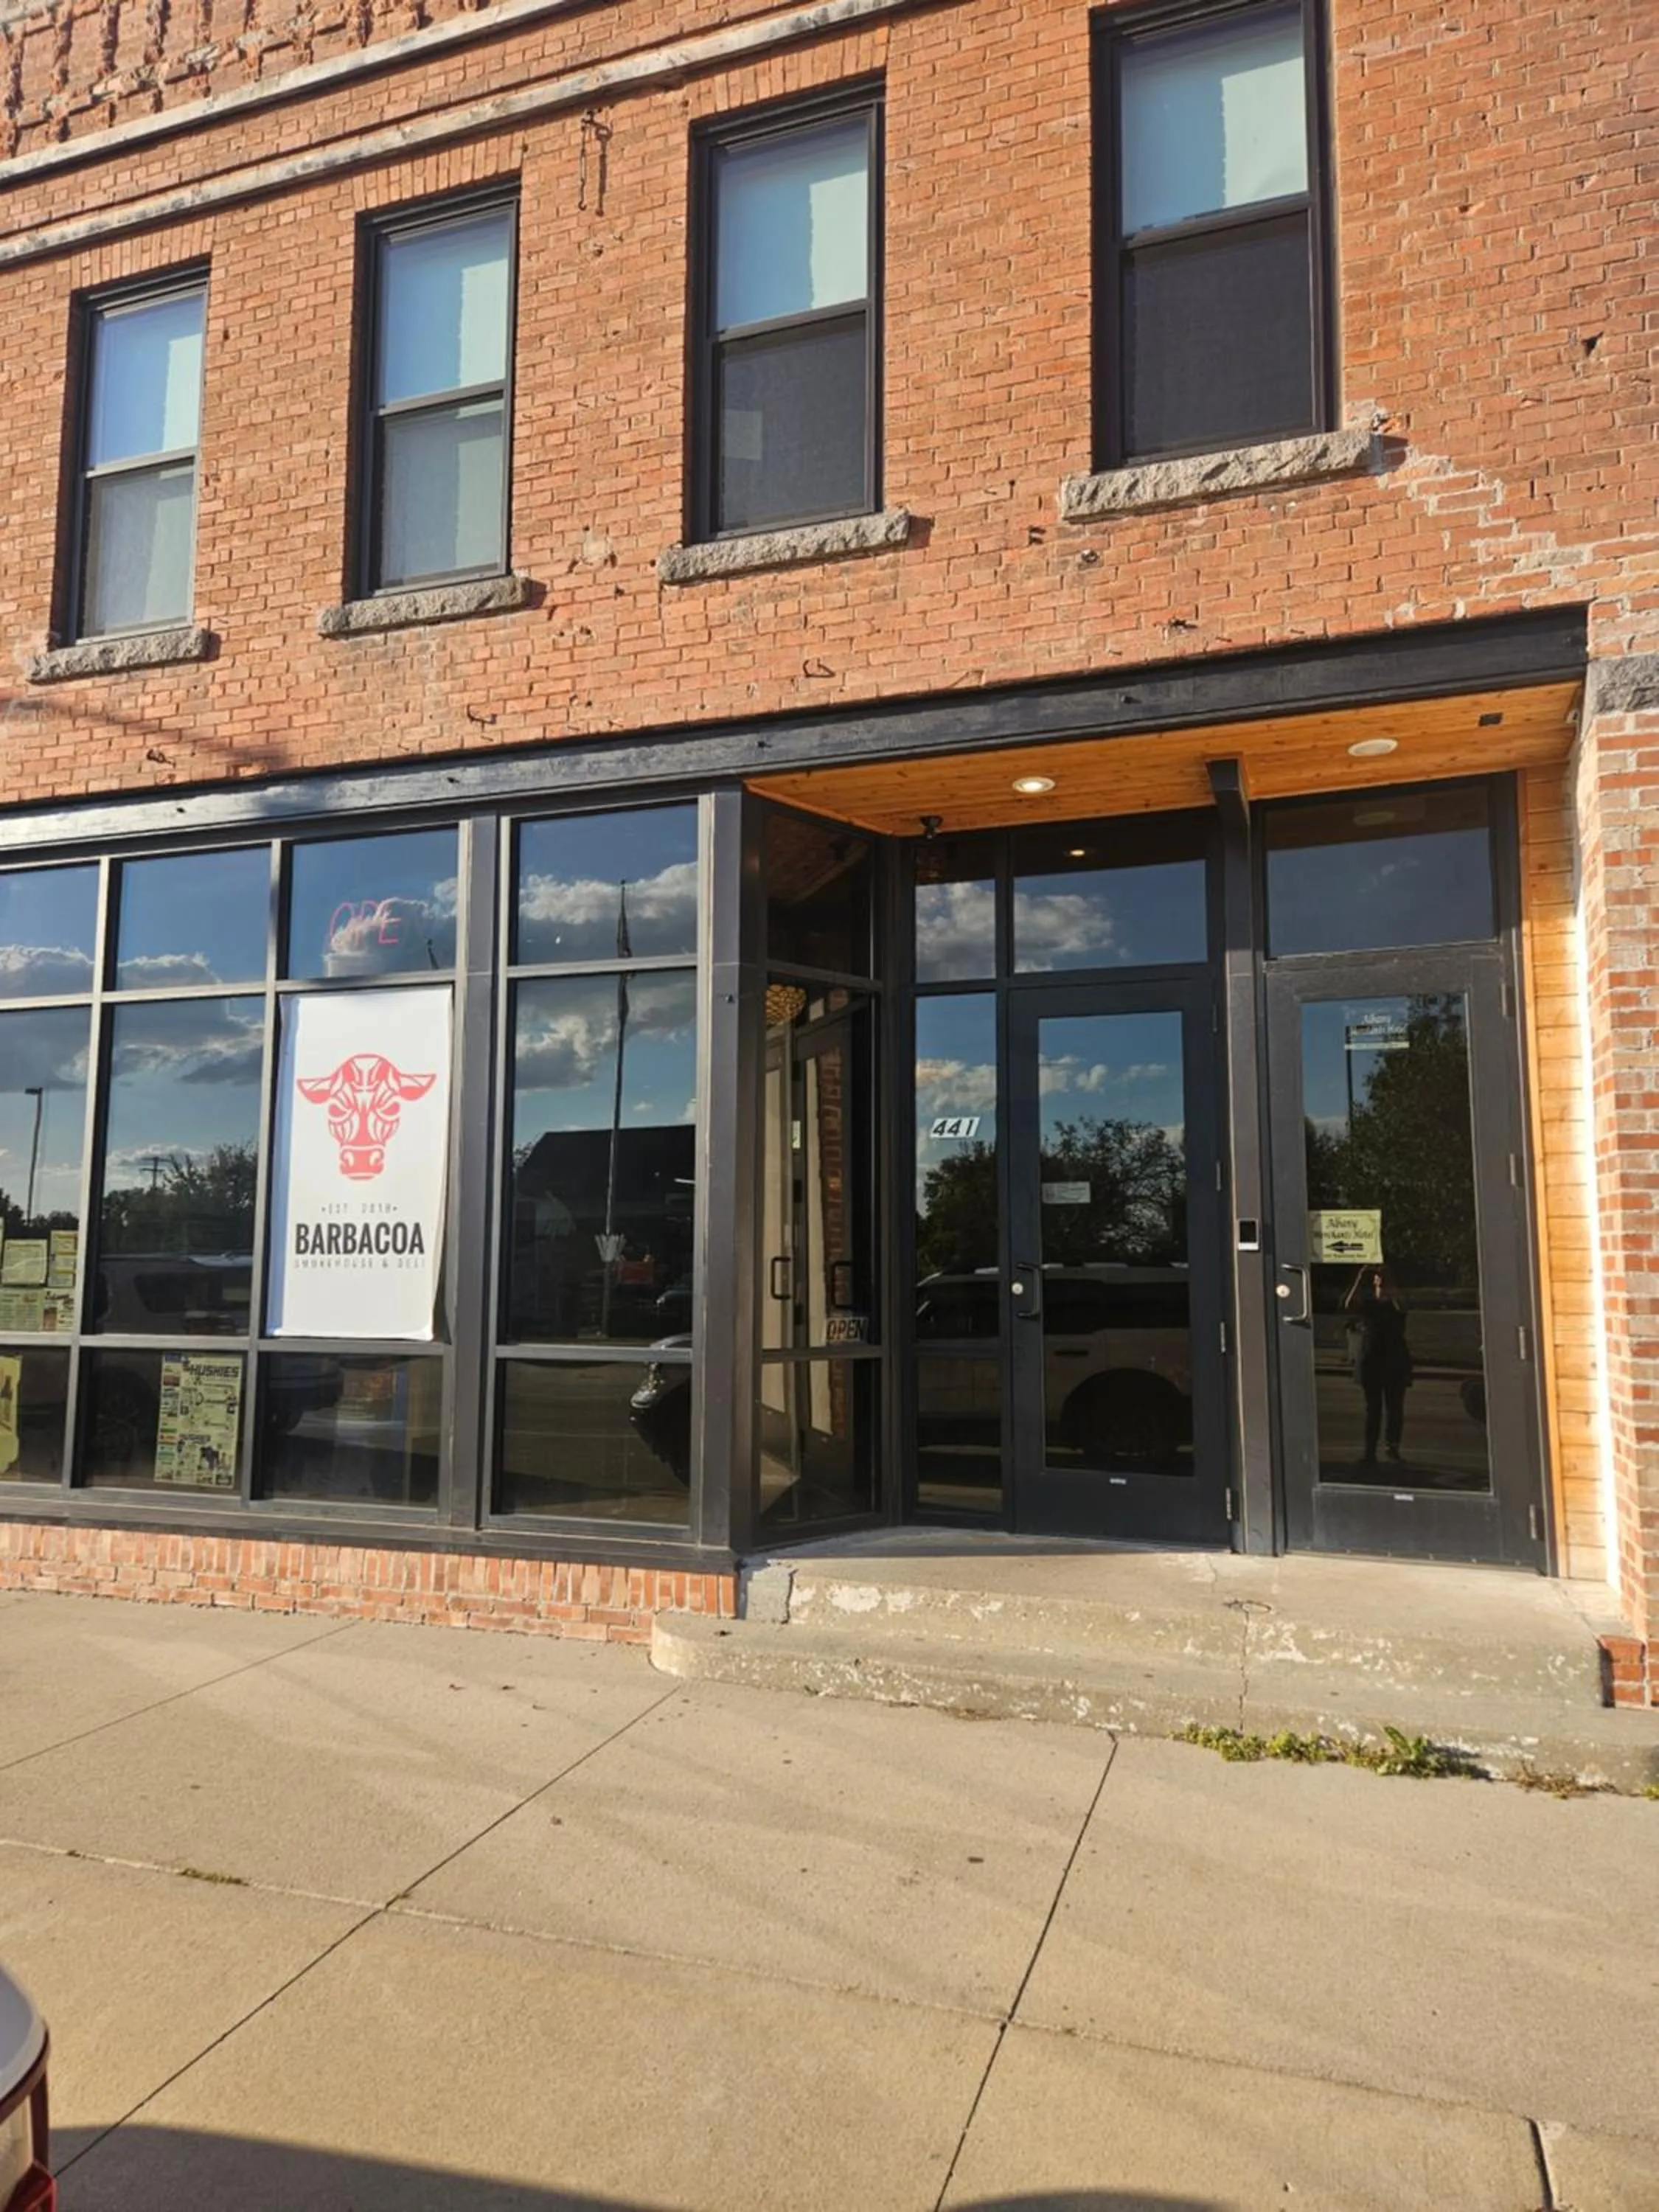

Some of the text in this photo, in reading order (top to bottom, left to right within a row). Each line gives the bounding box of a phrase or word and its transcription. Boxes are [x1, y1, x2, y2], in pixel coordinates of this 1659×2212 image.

[933, 1119, 974, 1136] 441
[296, 1222, 425, 1255] BARBACOA
[827, 1319, 867, 1340] OPEN
